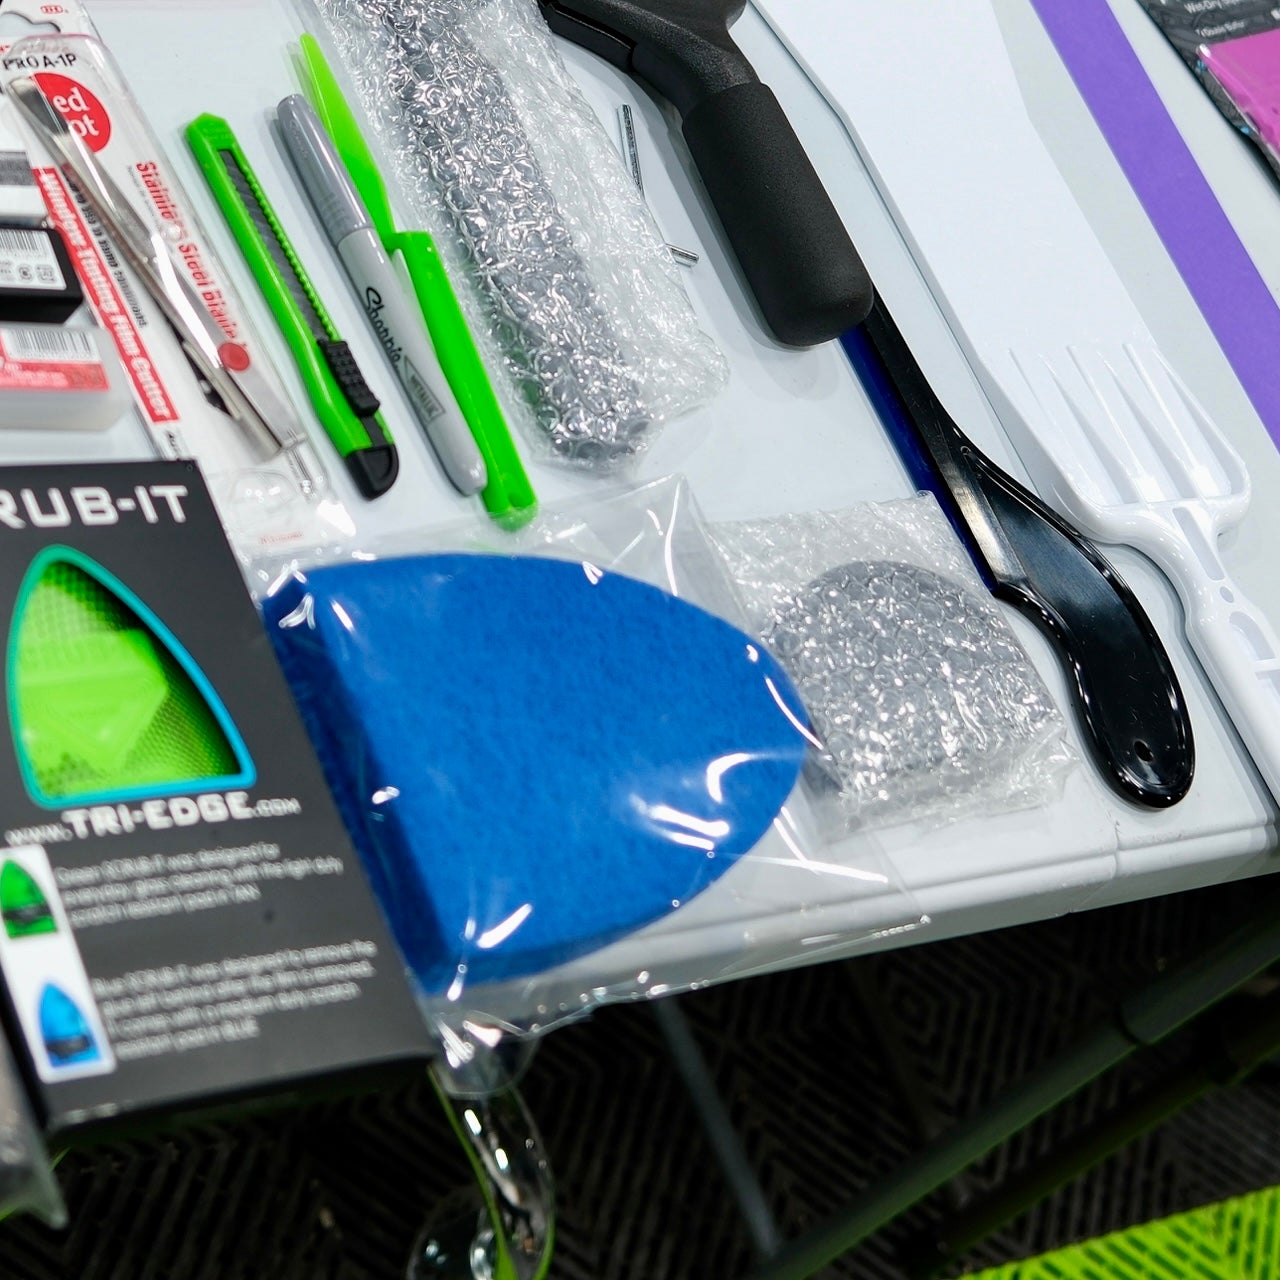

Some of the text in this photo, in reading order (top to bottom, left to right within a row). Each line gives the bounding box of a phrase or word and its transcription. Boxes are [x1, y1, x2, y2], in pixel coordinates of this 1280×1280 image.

[2, 52, 78, 71] PRO A-1P
[52, 86, 91, 113] ed
[70, 114, 100, 137] ot
[40, 172, 171, 418] Window Tinting Film Cutter
[4, 790, 302, 847] www.TRI-EDGE.com
